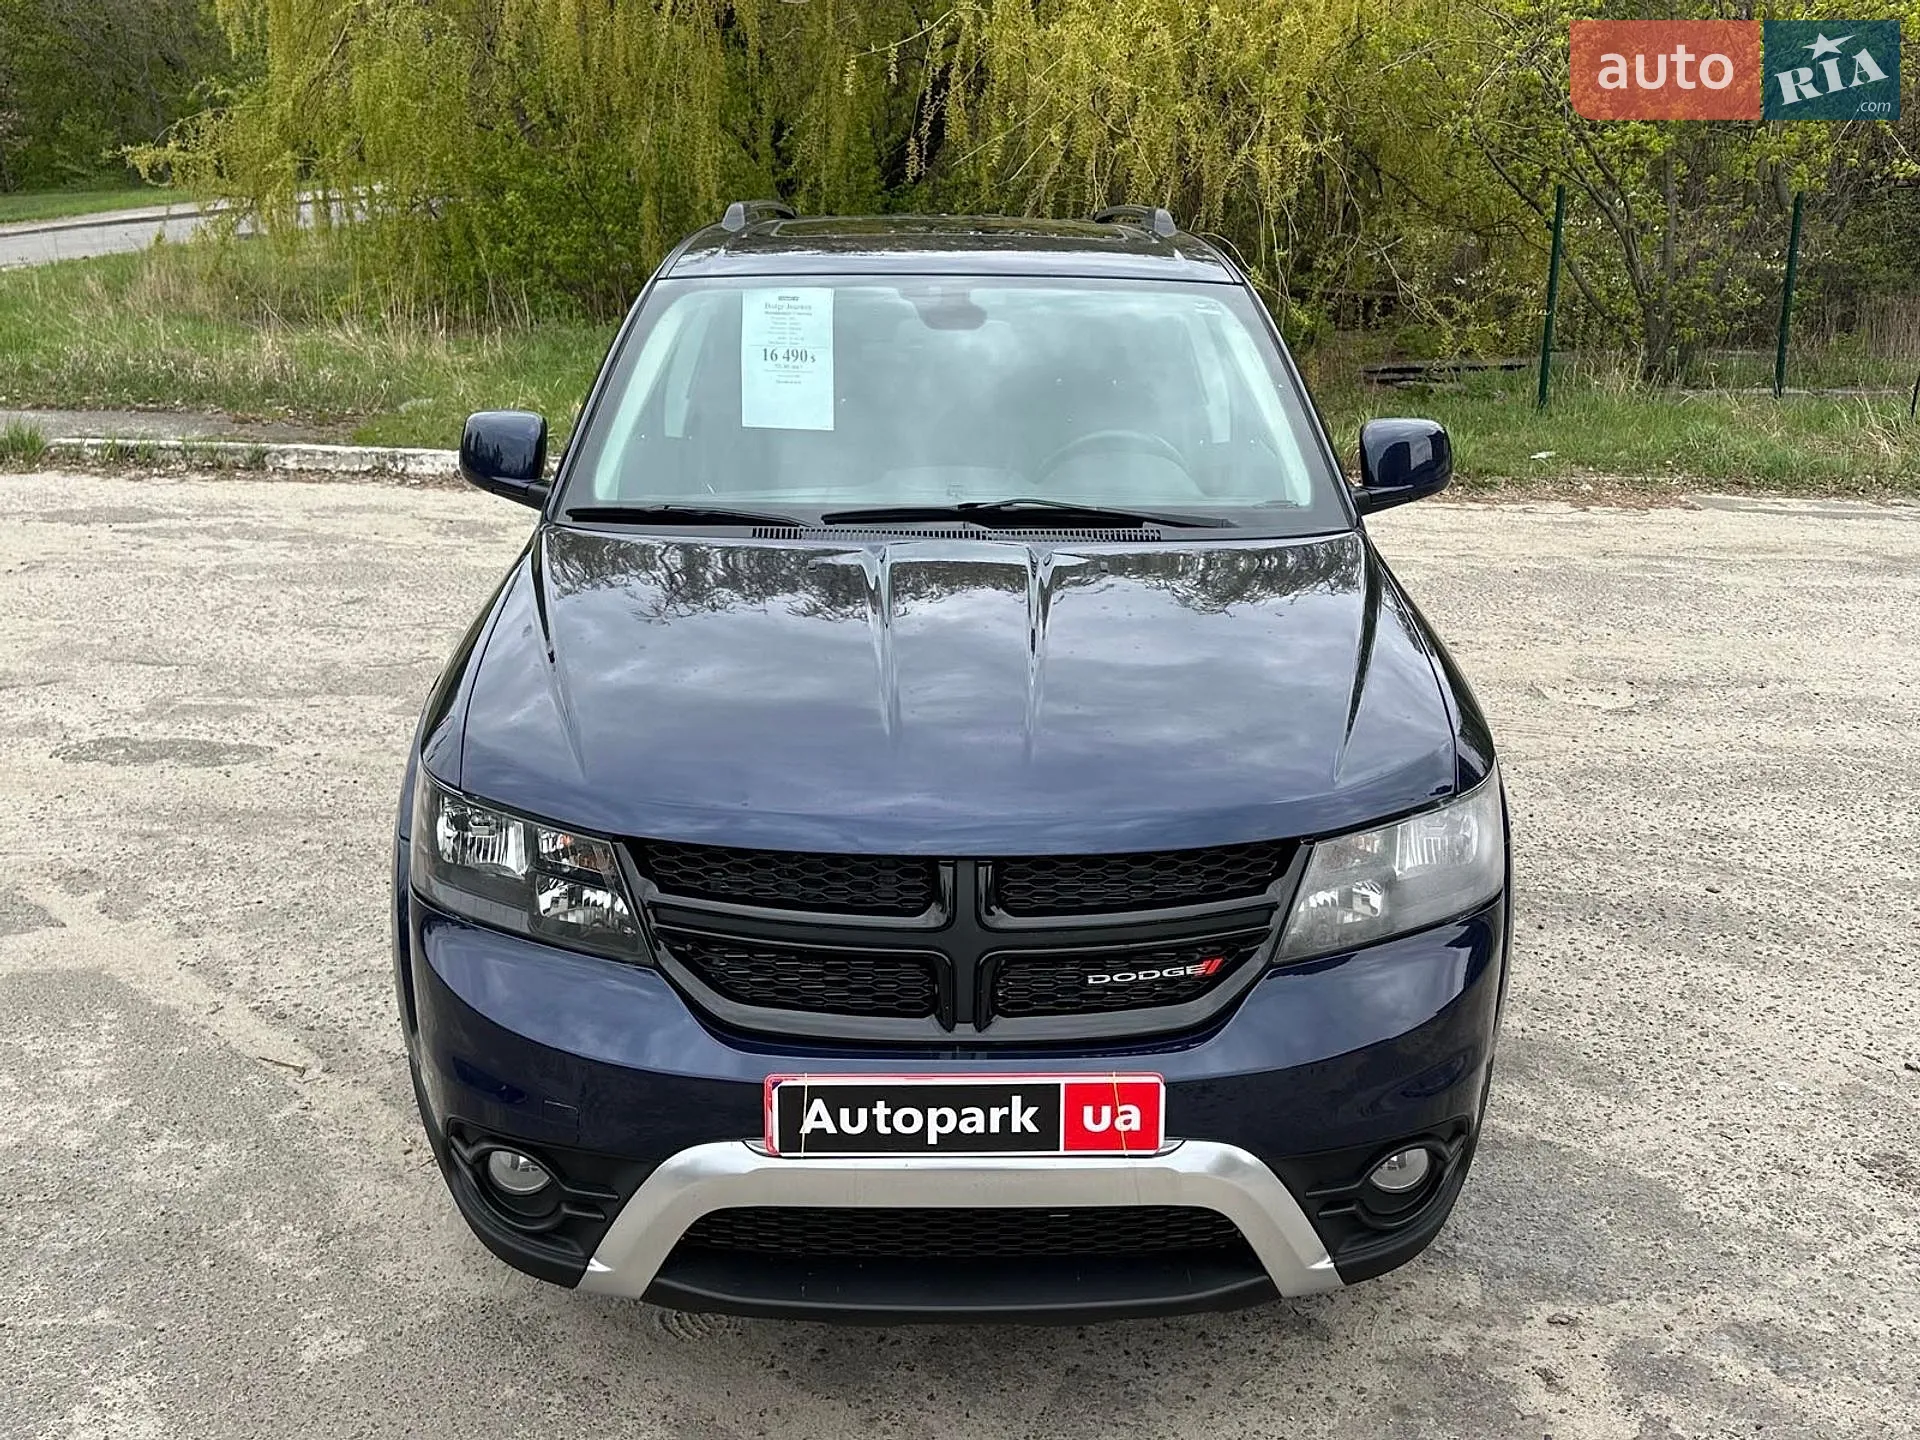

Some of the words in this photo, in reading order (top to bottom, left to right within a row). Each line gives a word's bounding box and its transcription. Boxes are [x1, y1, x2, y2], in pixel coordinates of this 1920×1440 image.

[763, 348, 778, 361] 16
[782, 348, 808, 363] 490
[1087, 963, 1207, 984] DODGE
[799, 1095, 1040, 1145] Autopark
[1082, 1103, 1141, 1132] ua
